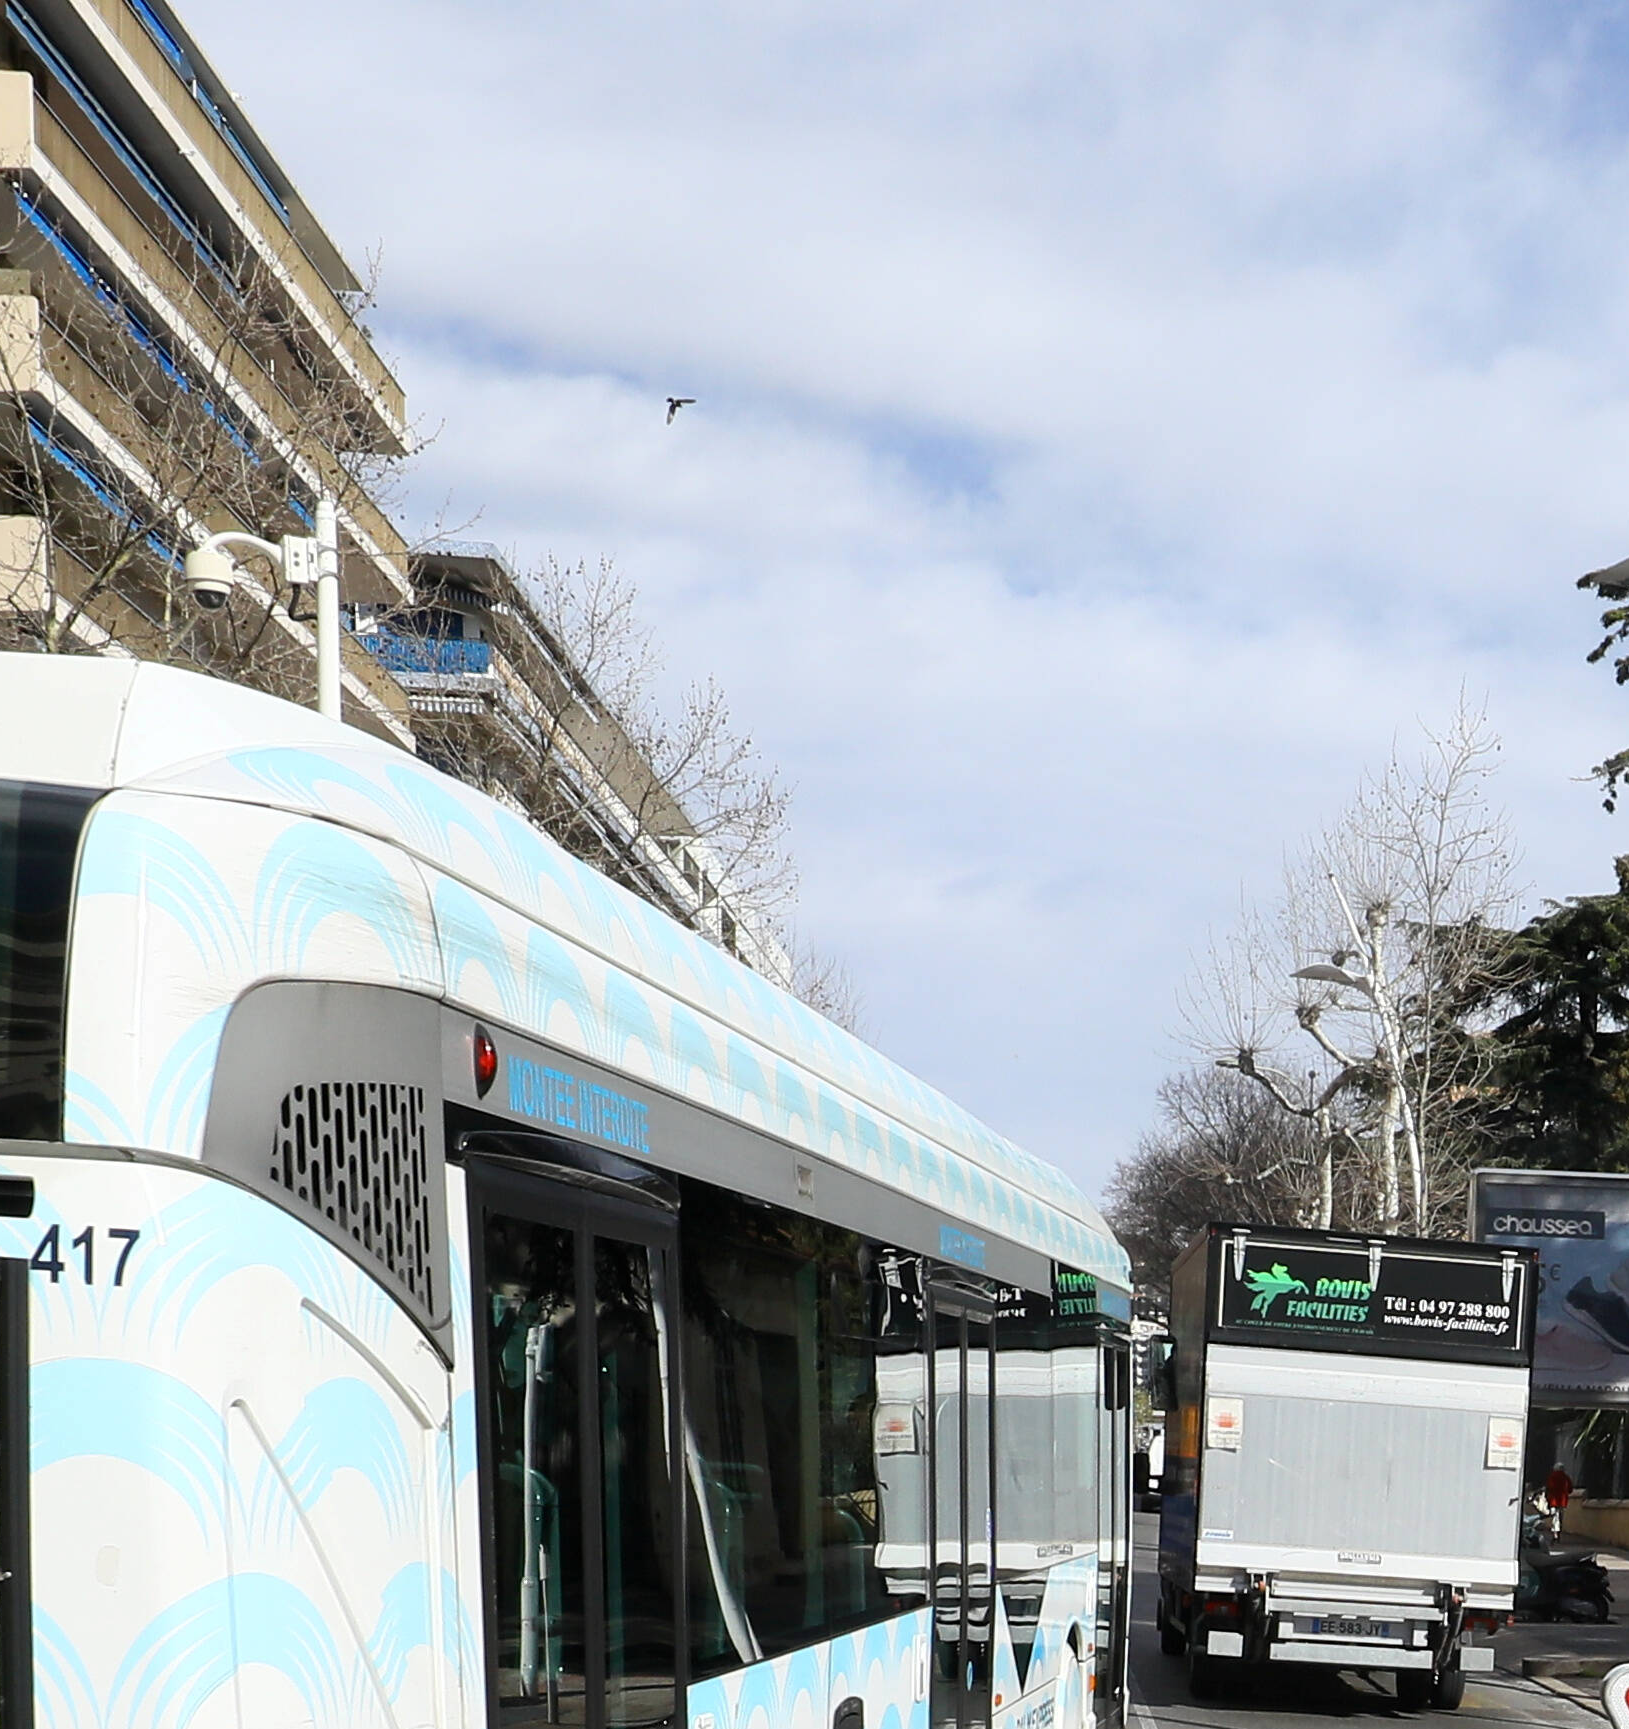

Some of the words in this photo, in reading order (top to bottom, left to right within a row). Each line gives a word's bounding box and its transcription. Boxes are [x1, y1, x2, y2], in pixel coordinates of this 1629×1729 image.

[507, 1053, 576, 1130] MONTEE
[578, 1079, 650, 1154] INTERDITE
[1493, 1214, 1593, 1236] chaussea
[30, 1223, 141, 1287] 417
[1315, 1277, 1370, 1300] BOVIS
[1286, 1300, 1370, 1323] FACILITIES
[1383, 1296, 1407, 1311] Tél
[1418, 1298, 1435, 1314] 04
[1438, 1300, 1455, 1315] 97
[1457, 1301, 1483, 1318] 288
[1485, 1303, 1510, 1319] 800
[1383, 1313, 1509, 1336] www.bovis-facilities.fr
